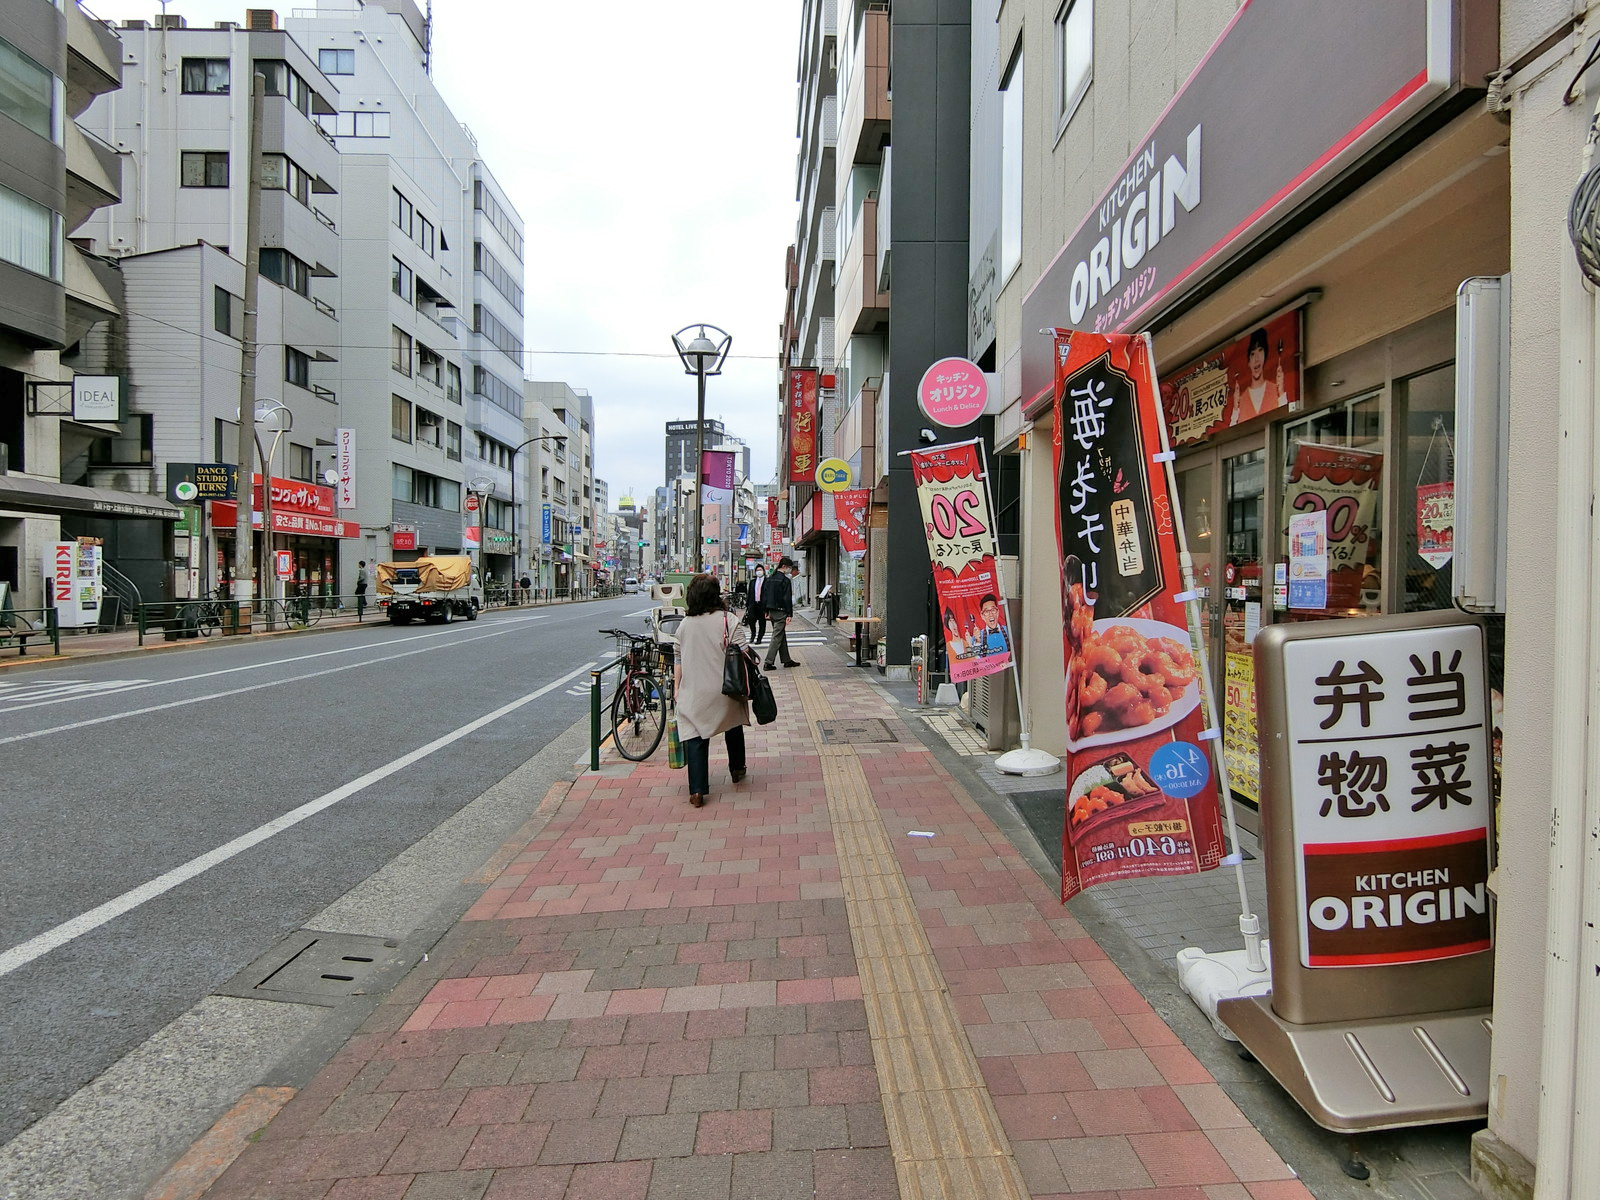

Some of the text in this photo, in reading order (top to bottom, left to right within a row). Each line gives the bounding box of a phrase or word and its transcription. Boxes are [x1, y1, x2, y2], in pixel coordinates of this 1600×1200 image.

[1099, 140, 1155, 233] KITCHEN
[1069, 123, 1202, 325] ORIGIN
[1093, 266, 1156, 333] キッチンオリジン
[936, 371, 969, 384] キッチン
[80, 391, 115, 402] IDEAL
[929, 384, 981, 402] オリジン
[1195, 384, 1229, 416] 戻ってくる!
[685, 422, 711, 430] LIVEAX
[196, 474, 228, 482] STUDIO
[725, 456, 733, 475] TOKYO
[196, 482, 228, 491] TURNS
[55, 545, 71, 600] KIRIN
[1313, 649, 1465, 730] 弁当
[1317, 741, 1473, 818] 惣菜
[1355, 867, 1449, 892] KITCHEN
[1308, 881, 1486, 931] ORIGIN
